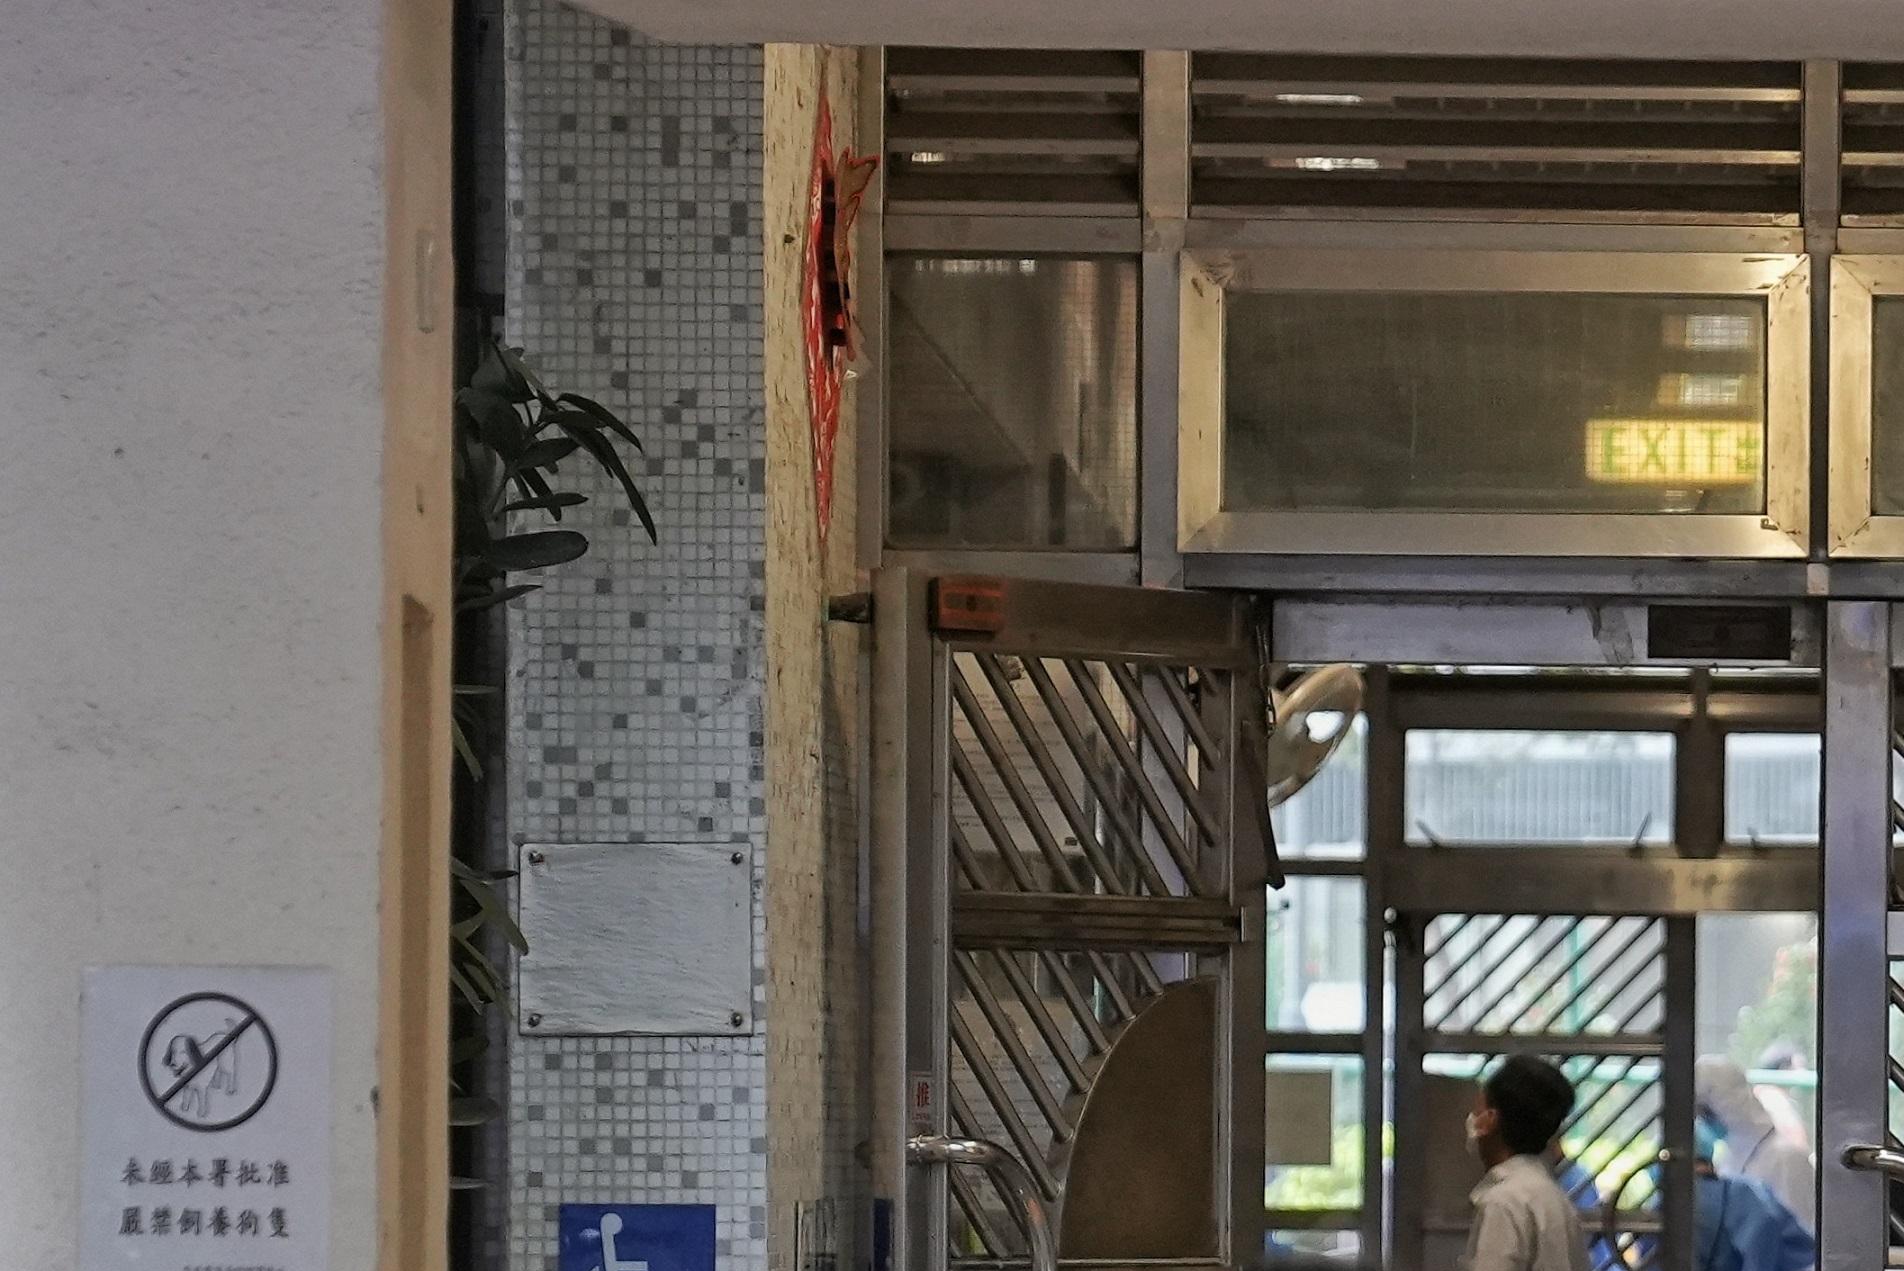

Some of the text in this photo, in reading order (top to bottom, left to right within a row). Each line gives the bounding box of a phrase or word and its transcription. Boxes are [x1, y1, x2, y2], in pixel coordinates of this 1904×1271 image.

[1602, 427, 1727, 474] EXIT
[120, 1156, 291, 1188] 未經本署批准
